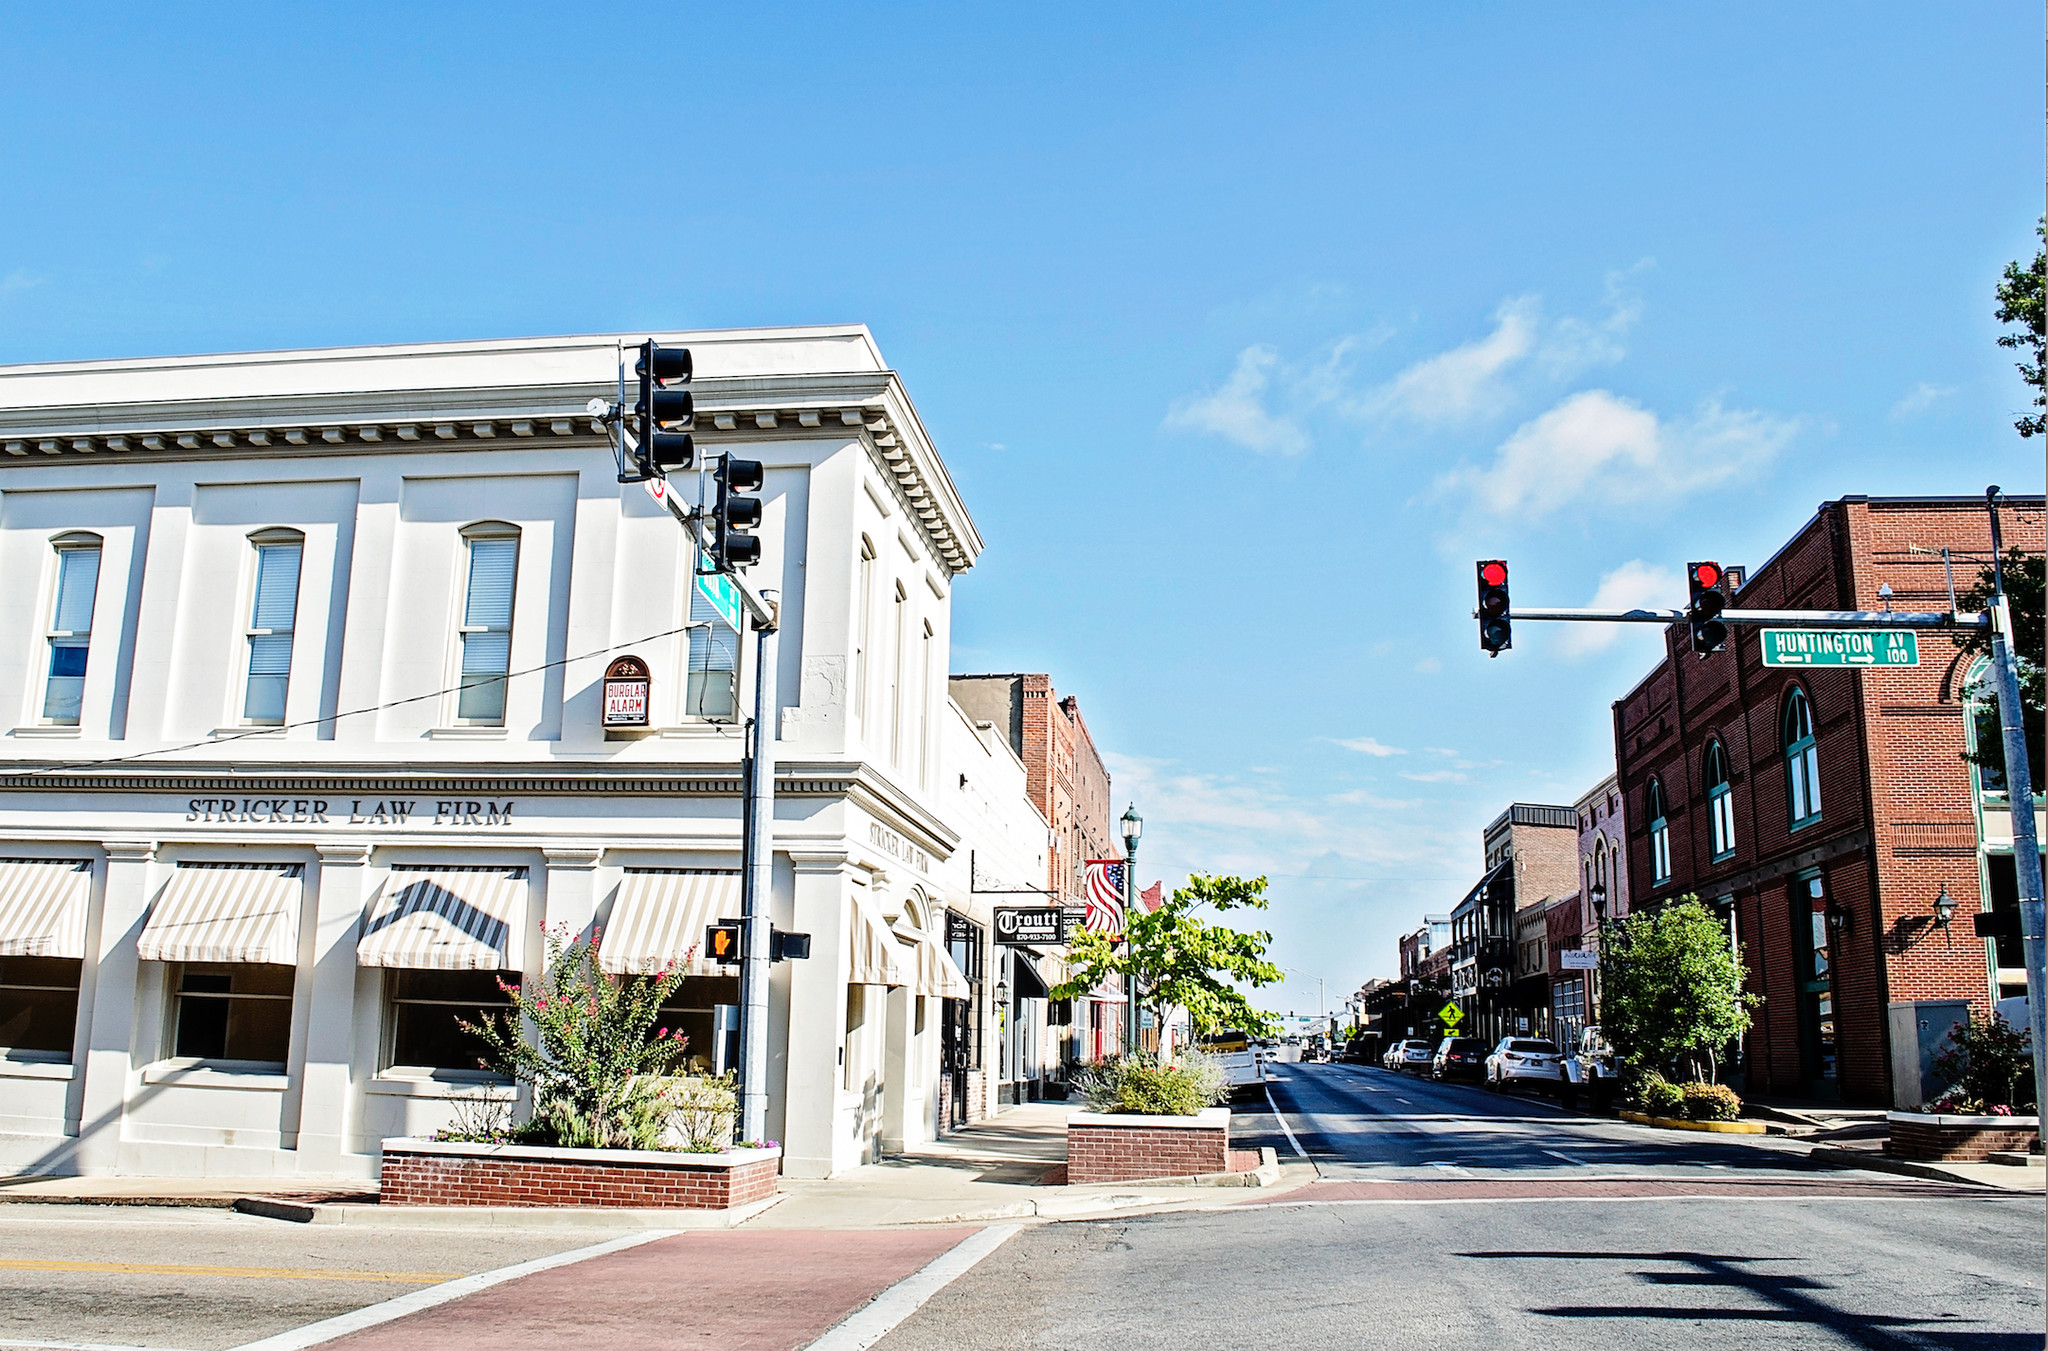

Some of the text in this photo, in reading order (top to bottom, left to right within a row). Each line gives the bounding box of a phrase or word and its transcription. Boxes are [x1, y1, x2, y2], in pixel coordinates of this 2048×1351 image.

[1775, 633, 1904, 653] HUNTINGTON AV
[1804, 653, 1847, 664] W E
[1886, 648, 1908, 663] 100
[608, 684, 646, 698] BURGLAR
[609, 699, 642, 713] ALARM
[186, 799, 515, 826] STRICKER LAW FIRM
[997, 910, 1058, 934] Troutt
[1016, 933, 1057, 941] 870-933-7100
